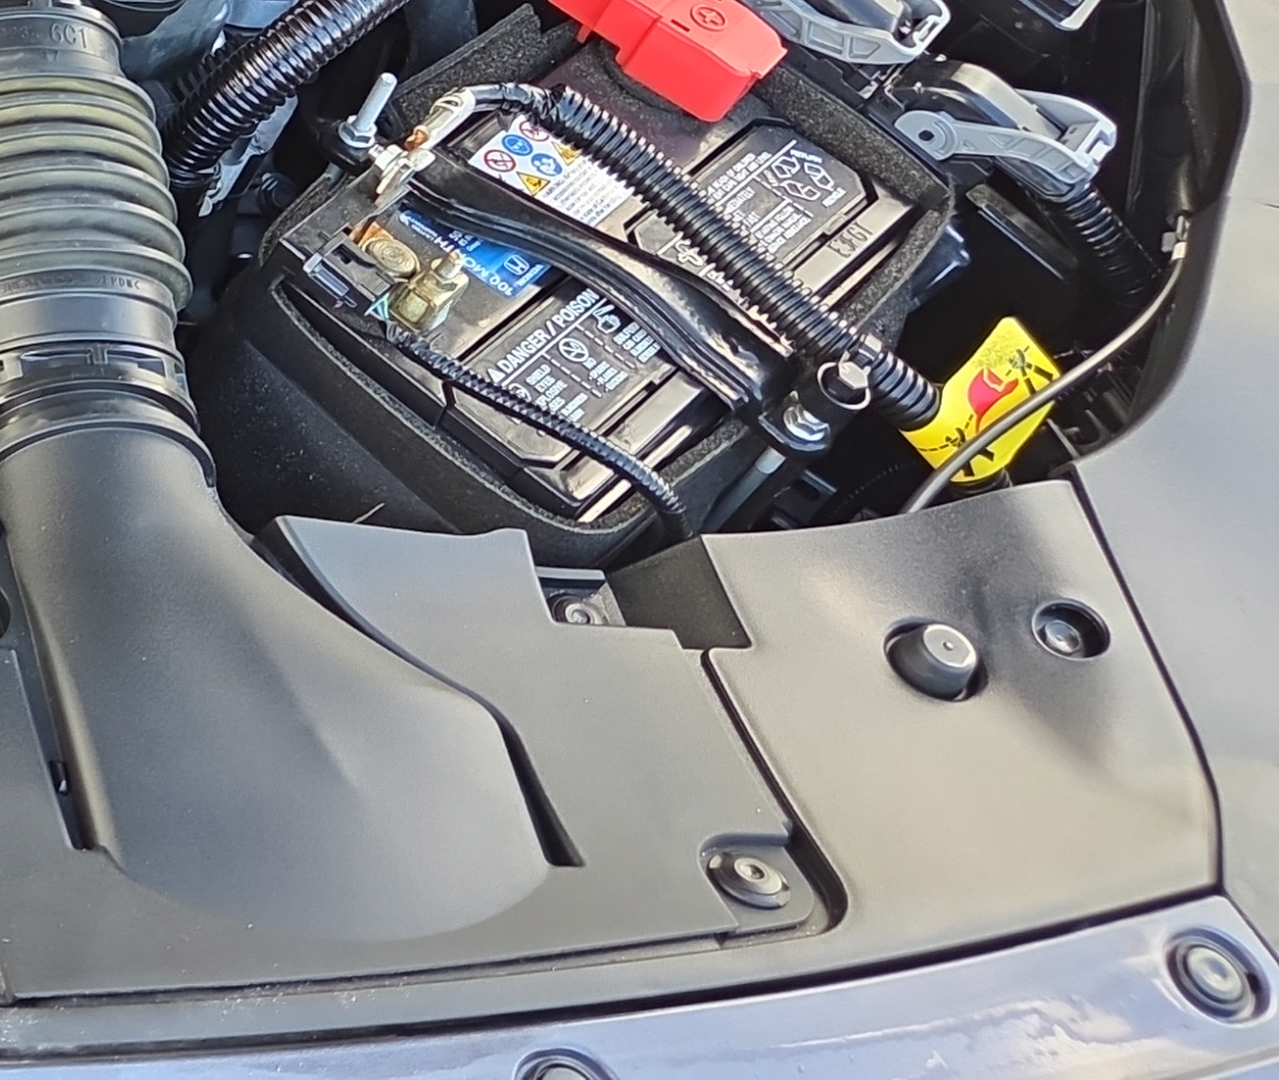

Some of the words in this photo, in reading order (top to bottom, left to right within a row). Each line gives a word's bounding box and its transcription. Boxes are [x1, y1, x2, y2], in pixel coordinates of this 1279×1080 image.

[49, 22, 89, 50] 6C1
[515, 262, 544, 287] HONDA
[497, 326, 551, 375] DANGER
[551, 285, 600, 329] POISON
